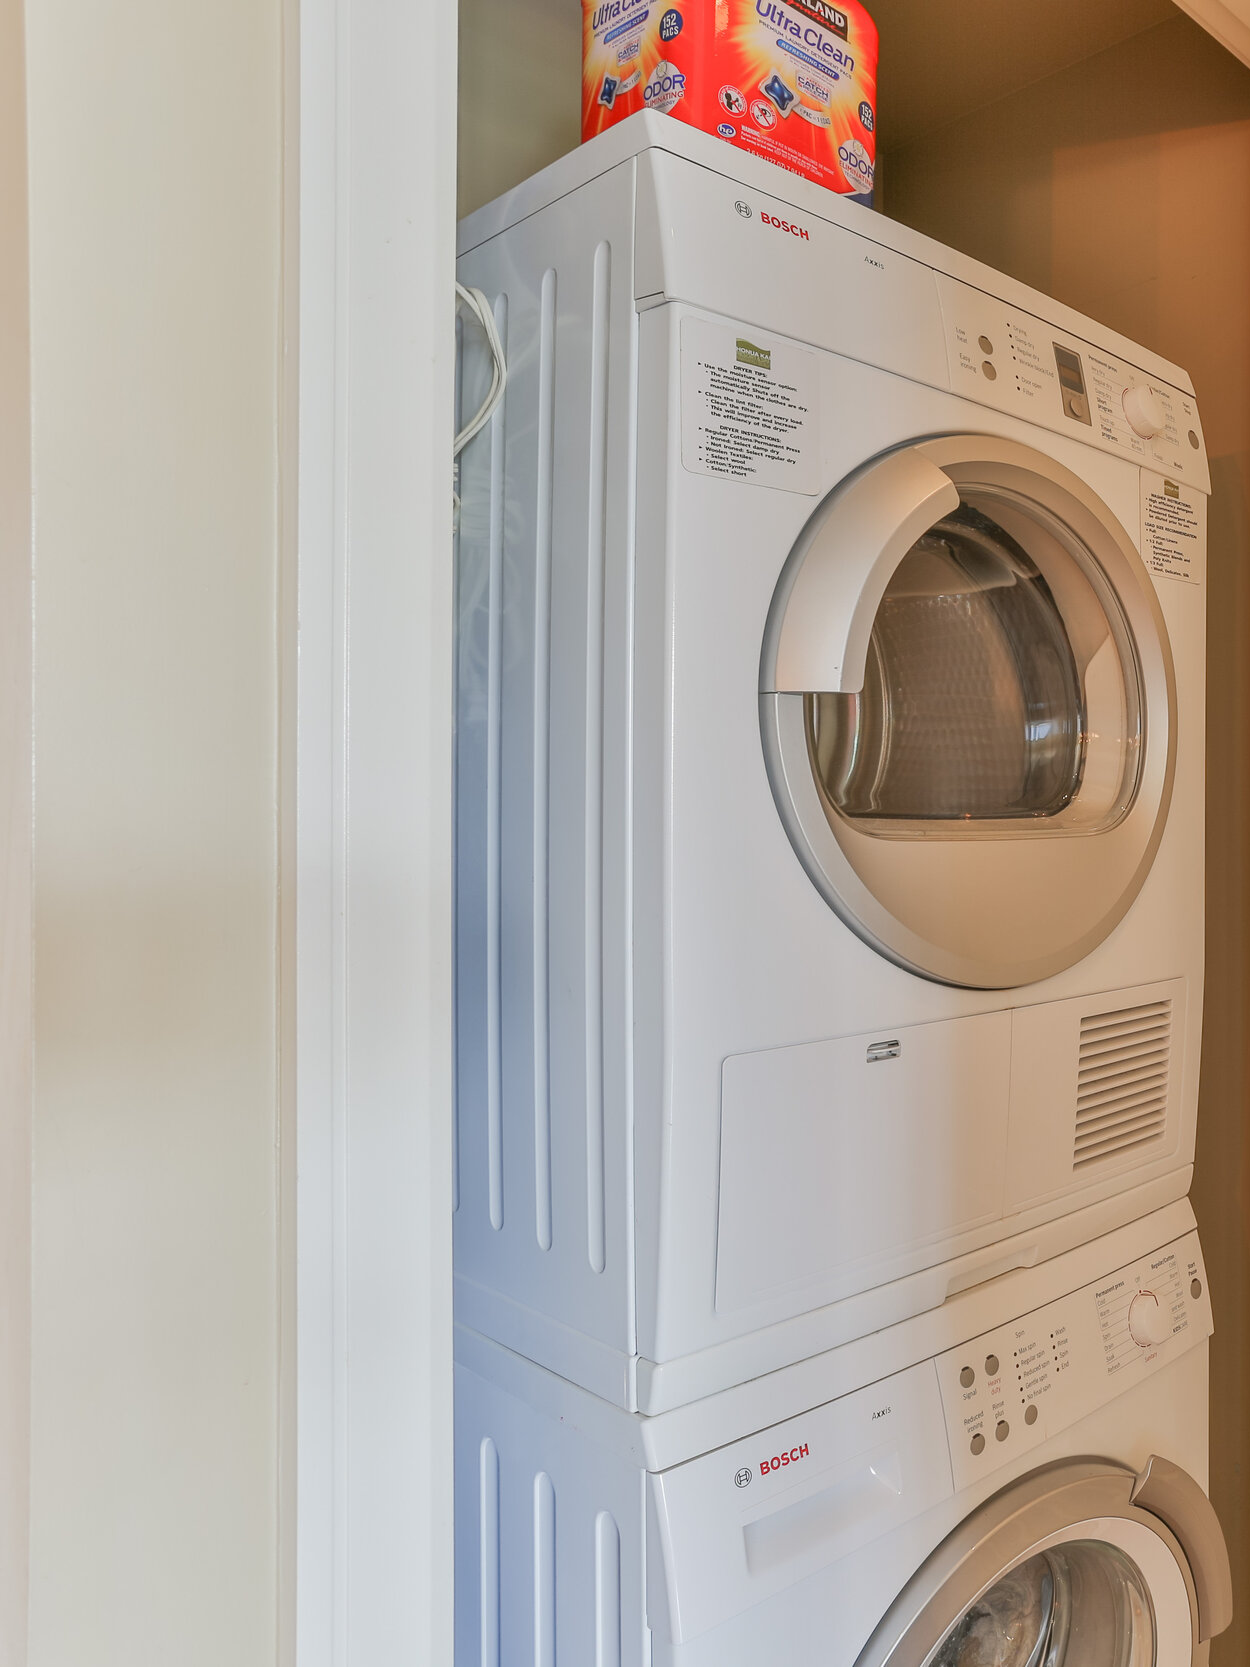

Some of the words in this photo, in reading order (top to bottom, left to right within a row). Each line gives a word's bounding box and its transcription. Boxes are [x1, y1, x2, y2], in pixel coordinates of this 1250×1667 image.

[662, 13, 677, 29] 152
[758, 19, 785, 39] PREMIUM
[662, 26, 679, 39] PACS
[781, 41, 818, 68] REFRESHING
[818, 63, 836, 78] SCENT
[643, 74, 685, 101] ODOR
[798, 76, 829, 99] CATCH
[861, 104, 873, 122] 152
[760, 211, 810, 241] BOSCH
[863, 255, 885, 270] Axxis
[704, 363, 716, 373] Use
[729, 370, 756, 381] moisture
[757, 378, 777, 387] sensor
[733, 365, 753, 374] DRYER
[754, 370, 768, 378] TIPS:
[710, 370, 722, 378] The
[722, 375, 750, 385] moisture
[751, 382, 771, 391] sensor
[710, 378, 751, 392] automatically
[752, 387, 769, 396] Shuts
[704, 391, 722, 401] Clean
[735, 398, 746, 406] lint
[709, 383, 735, 393] machine
[736, 390, 754, 398] when
[765, 397, 786, 407] clothes
[710, 398, 728, 408] Clean
[729, 403, 740, 411] the
[741, 406, 756, 414] filter
[773, 415, 789, 423] every
[710, 404, 723, 412] This
[737, 411, 761, 421] improve
[774, 420, 797, 430] increase
[722, 414, 752, 426] efficiency
[772, 425, 789, 434] dryer.
[704, 427, 728, 437] Regular
[785, 446, 801, 454] Press
[719, 424, 739, 434] DRYER
[740, 429, 782, 443] INSTRUCTIONS:
[705, 446, 728, 456] Woolen
[729, 451, 754, 461] Textiles:
[710, 441, 722, 450] Not
[745, 449, 764, 457] Select
[764, 454, 785, 462] regular
[733, 440, 751, 449] Select
[752, 444, 769, 453] damp
[769, 448, 780, 456] dry
[710, 453, 729, 462] Select
[710, 465, 729, 474] Select
[1095, 1285, 1115, 1299] Permanent
[1114, 1280, 1125, 1290] press
[1014, 1329, 1026, 1339] Spin
[1018, 1346, 1027, 1355] Max
[1027, 1341, 1037, 1352] spin
[1020, 1355, 1037, 1367] Regular
[1036, 1349, 1045, 1360] spin
[1061, 1361, 1070, 1370] End
[1023, 1365, 1041, 1378] Reduced
[1041, 1360, 1051, 1370] spin
[987, 1377, 1002, 1388] Heavy
[1025, 1378, 1039, 1390] Gentle
[1038, 1373, 1048, 1384] spin
[962, 1388, 978, 1401] Signal
[990, 1386, 1001, 1396] duty
[1027, 1393, 1034, 1401] No
[1033, 1388, 1043, 1398] final
[1042, 1383, 1052, 1394] spin
[871, 1406, 892, 1421] Axxis
[991, 1400, 1005, 1411] Rinse
[963, 1410, 984, 1426] Reduced
[994, 1409, 1005, 1420] plus
[967, 1421, 984, 1434] ironing
[759, 1442, 810, 1476] BOSCH
